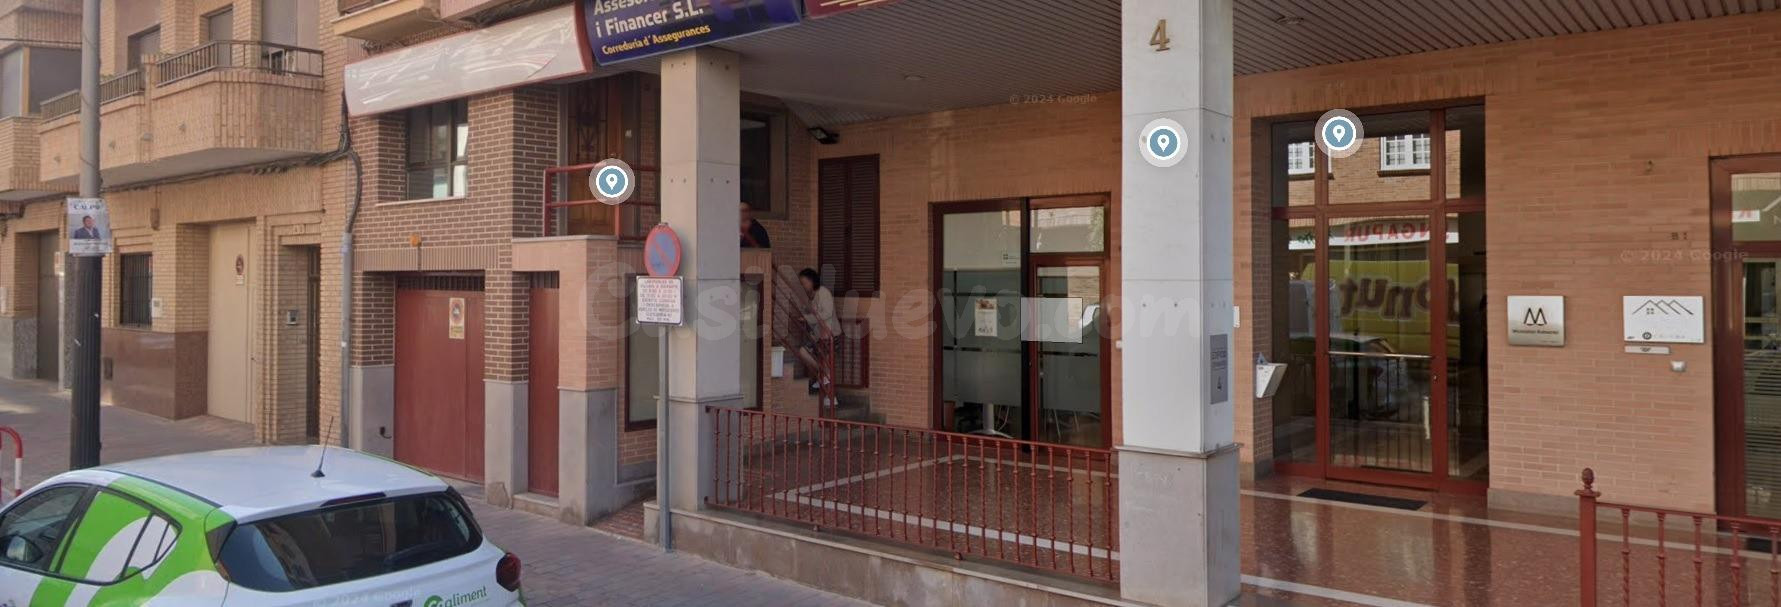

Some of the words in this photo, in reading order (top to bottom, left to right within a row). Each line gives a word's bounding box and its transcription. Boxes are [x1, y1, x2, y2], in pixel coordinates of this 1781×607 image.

[595, 21, 602, 38] i
[605, 9, 668, 36] Financer
[672, 0, 704, 20] S.L.
[652, 25, 711, 44] Assegurances
[1150, 19, 1170, 51] 4
